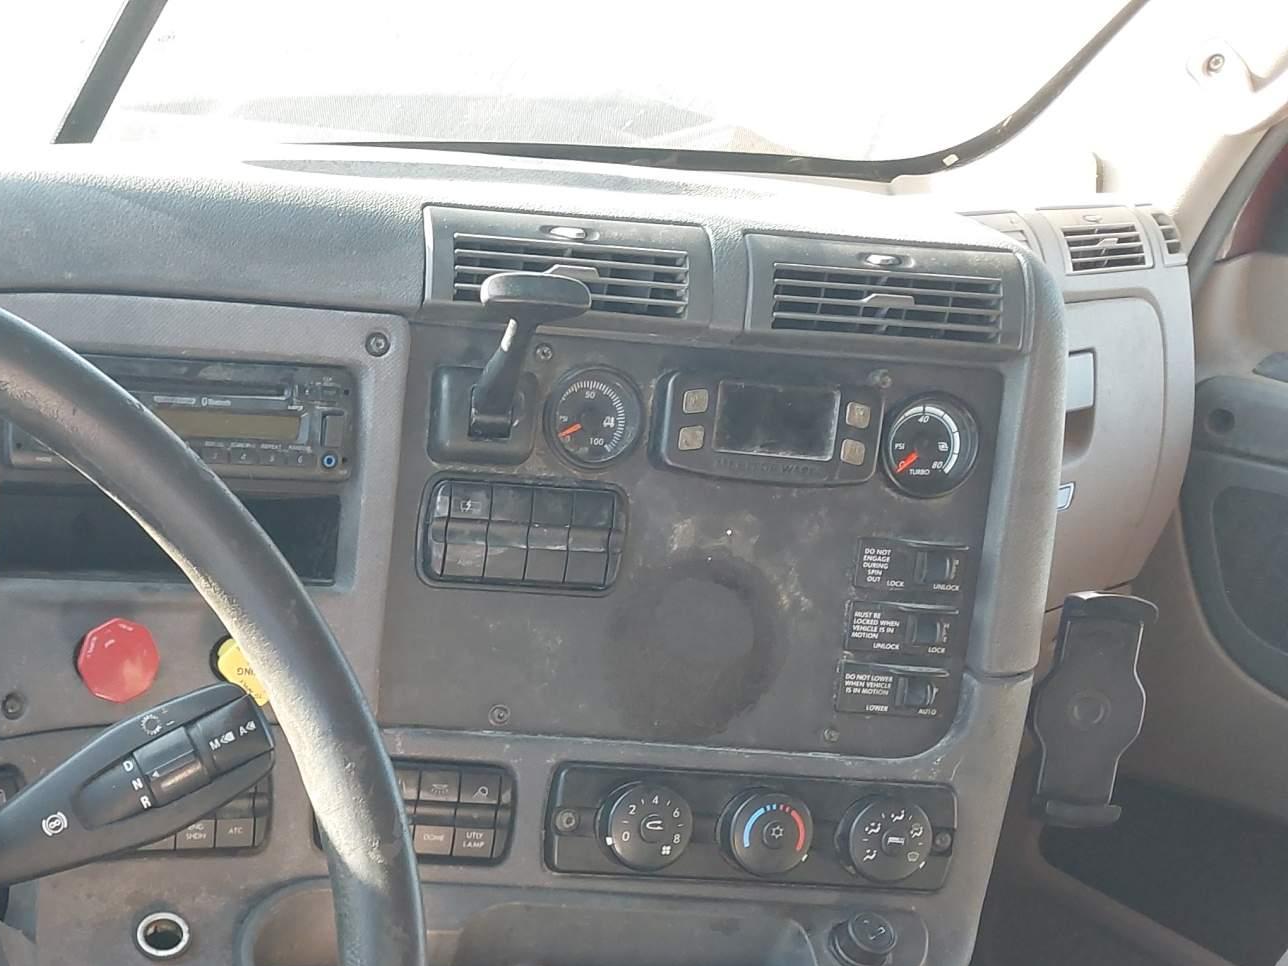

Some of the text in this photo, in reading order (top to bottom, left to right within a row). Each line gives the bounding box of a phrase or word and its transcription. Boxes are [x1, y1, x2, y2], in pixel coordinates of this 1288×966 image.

[584, 391, 596, 399] 50
[918, 415, 930, 423] 40
[590, 437, 605, 446] 100
[931, 461, 943, 469] 80
[909, 468, 931, 476] TURBO
[876, 548, 891, 556] NOT
[863, 555, 890, 563] ENGAGE
[862, 562, 889, 570] DURING
[933, 583, 960, 591] UNLOCK
[854, 611, 872, 619] MUST
[853, 618, 879, 626] LOCKED
[852, 625, 878, 633] VEHICLE
[873, 642, 900, 650] UNLOCK
[928, 646, 946, 654] LOCK
[865, 681, 891, 689] VEHICLE
[208, 726, 249, 752] M A
[123, 760, 134, 773] D
[132, 778, 144, 791] N
[140, 795, 152, 809] R
[652, 795, 659, 804] 4
[628, 804, 636, 815] 2
[672, 808, 680, 818] 6
[228, 826, 244, 834] ATC
[622, 831, 630, 841] 0
[673, 834, 681, 844] 8
